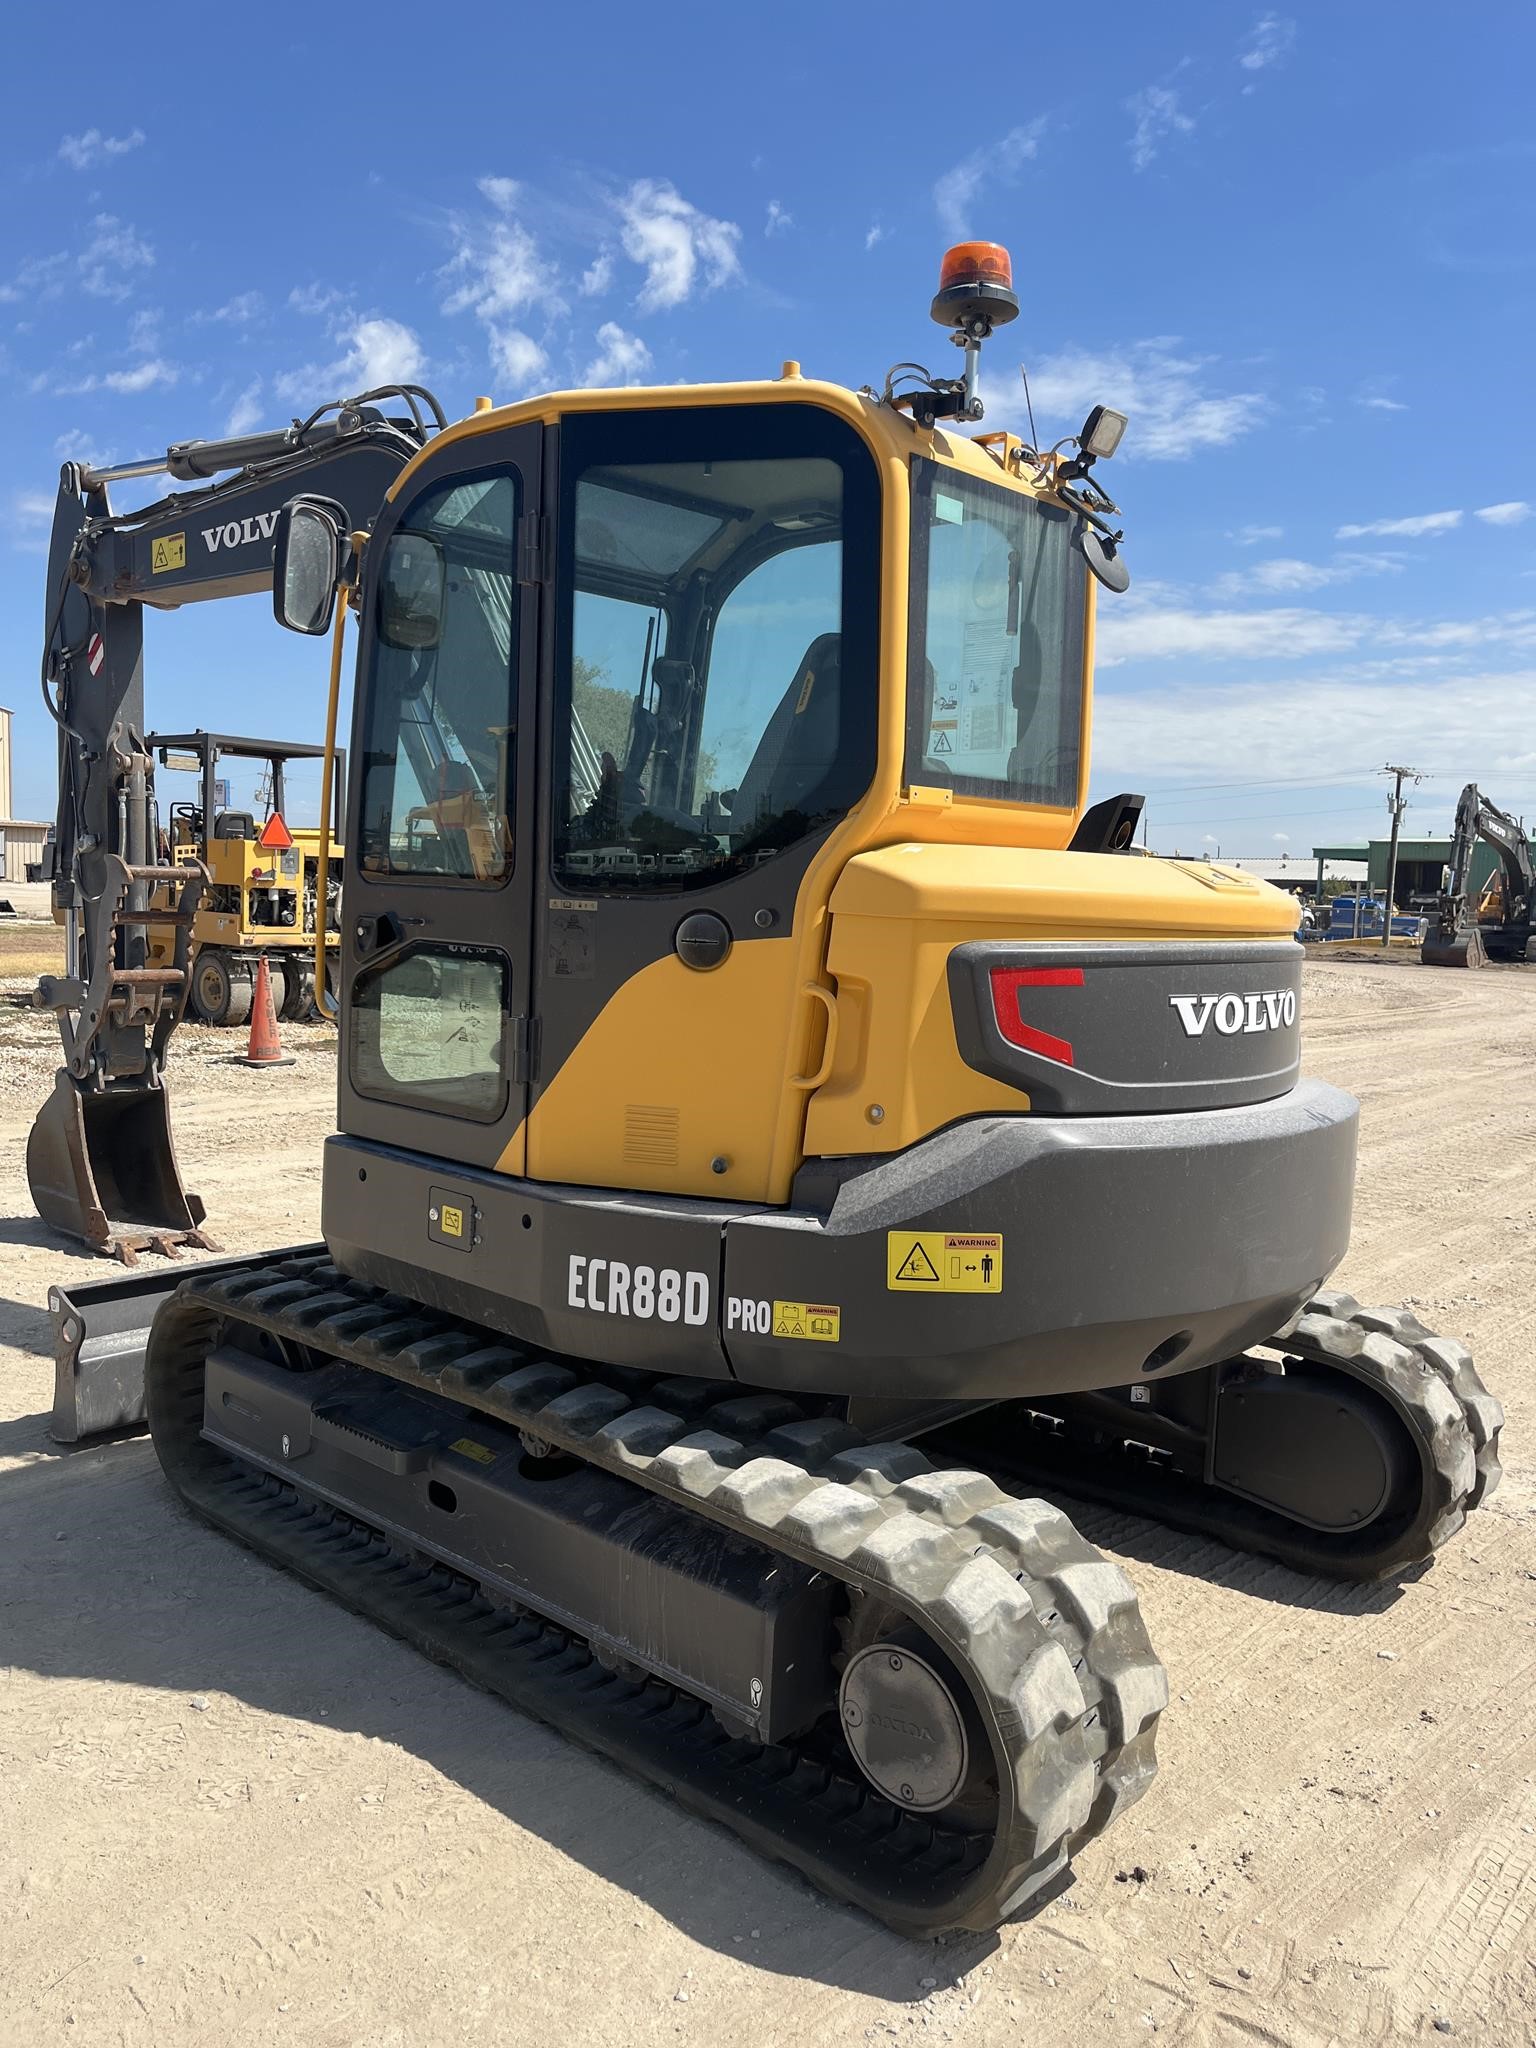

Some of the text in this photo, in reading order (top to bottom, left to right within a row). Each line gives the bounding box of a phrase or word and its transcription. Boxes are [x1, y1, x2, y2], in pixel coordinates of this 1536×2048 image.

[1169, 988, 1296, 1036] VOLVO
[957, 1239, 997, 1247] WARNING
[567, 1254, 771, 1335] ECR88D PRO
[811, 1307, 838, 1315] WARNING
